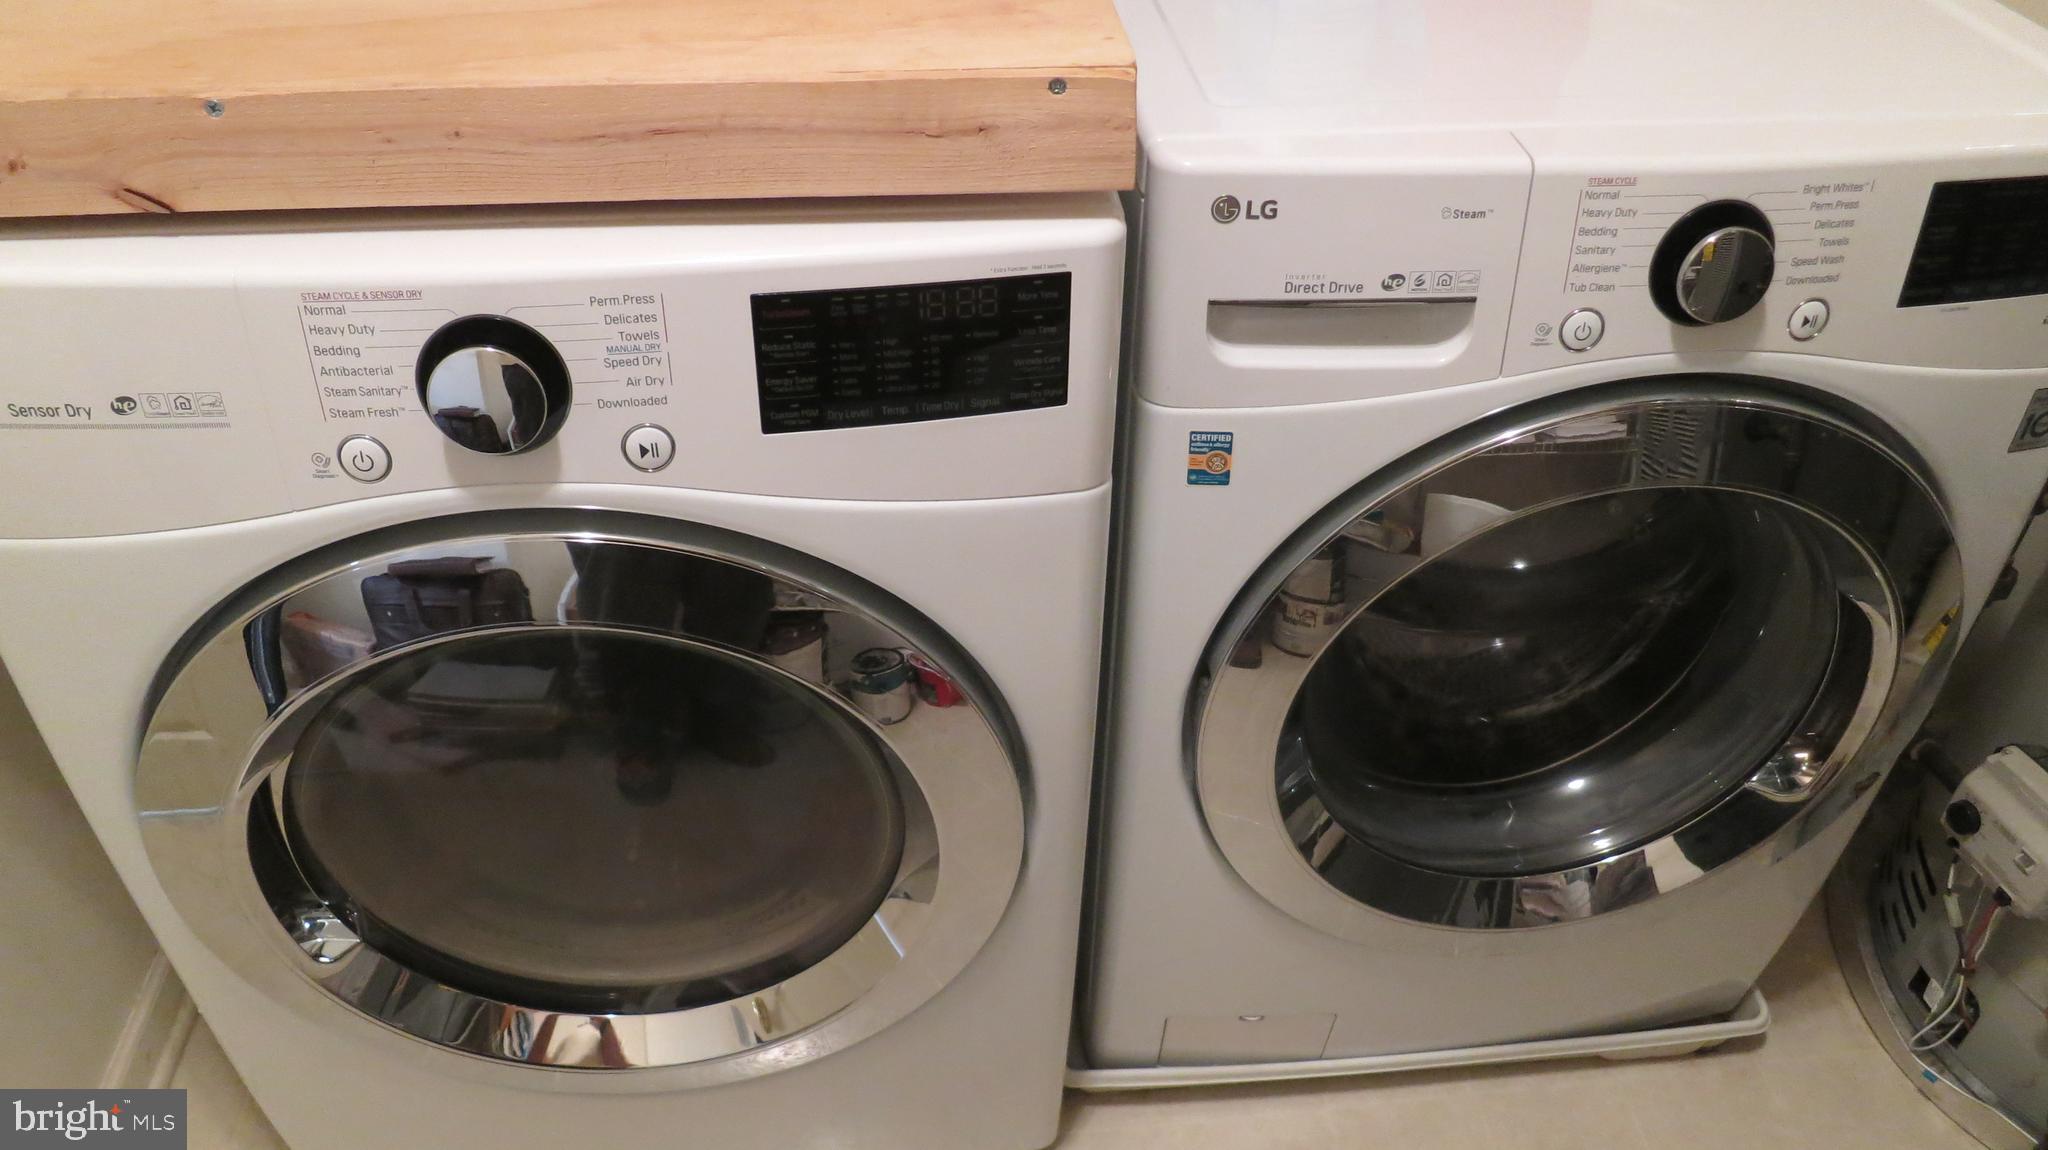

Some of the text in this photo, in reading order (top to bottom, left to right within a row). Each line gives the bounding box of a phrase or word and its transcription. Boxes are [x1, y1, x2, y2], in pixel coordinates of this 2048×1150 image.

[1588, 177, 1638, 185] STEAM CYCLE
[1585, 190, 1620, 200] Normal
[1803, 184, 1831, 196] Bright
[1245, 200, 1279, 220] LG
[1582, 208, 1638, 219] Heavy Duty
[1814, 218, 1855, 230] Delicates
[1578, 227, 1618, 238] Bedding
[1819, 237, 1849, 247] Towels
[1575, 245, 1616, 256] Sanitary
[1791, 254, 1845, 267] Speed Wash
[1785, 273, 1840, 286] Downloaded
[1284, 281, 1364, 294] Direct Drive
[1569, 282, 1615, 292] Tub Clean
[301, 289, 423, 301] STEAM CYCLE & SENSOR DRY
[304, 305, 346, 316] Normal
[604, 313, 658, 325] Delicates
[309, 324, 375, 336] Heavy Duty
[618, 330, 660, 341] Towels
[314, 346, 361, 358] Bedding
[606, 343, 661, 353] MANUAL DRY
[603, 355, 662, 369] Speed Dry
[320, 366, 393, 377] Antibacterial
[626, 375, 665, 387] Air Dry
[324, 386, 357, 397] Steam
[597, 395, 668, 409] Downloaded
[8, 403, 92, 420] Sensor Dry
[330, 407, 365, 418] Steam
[827, 407, 870, 420] Dry Level
[1191, 434, 1232, 442] CERTIFIED
